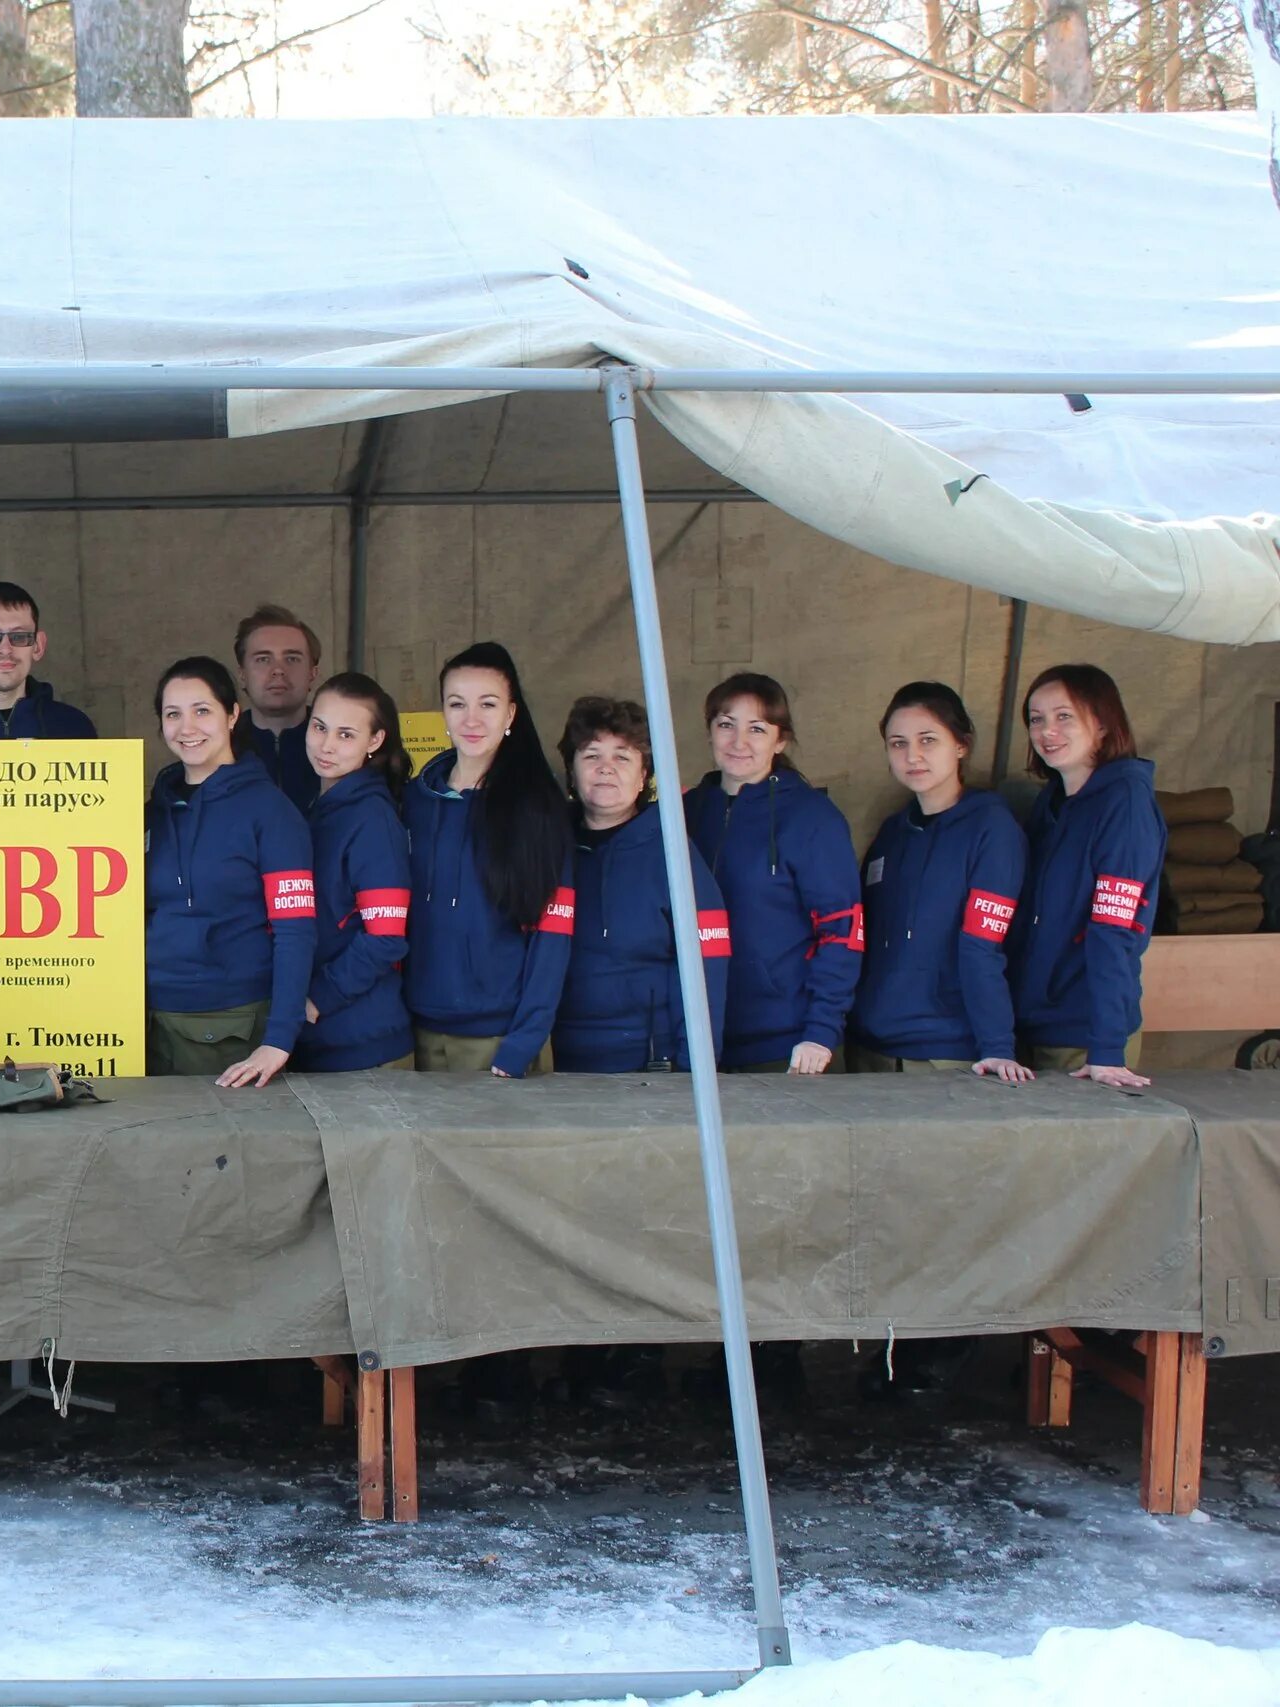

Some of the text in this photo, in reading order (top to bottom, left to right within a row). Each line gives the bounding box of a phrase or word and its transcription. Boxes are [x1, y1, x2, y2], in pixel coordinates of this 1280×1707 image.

[43, 761, 109, 785] ДМЦ
[24, 792, 105, 812] парус»
[6, 956, 95, 970] временного
[6, 1032, 21, 1047] г.
[28, 1027, 125, 1048] Тюмень
